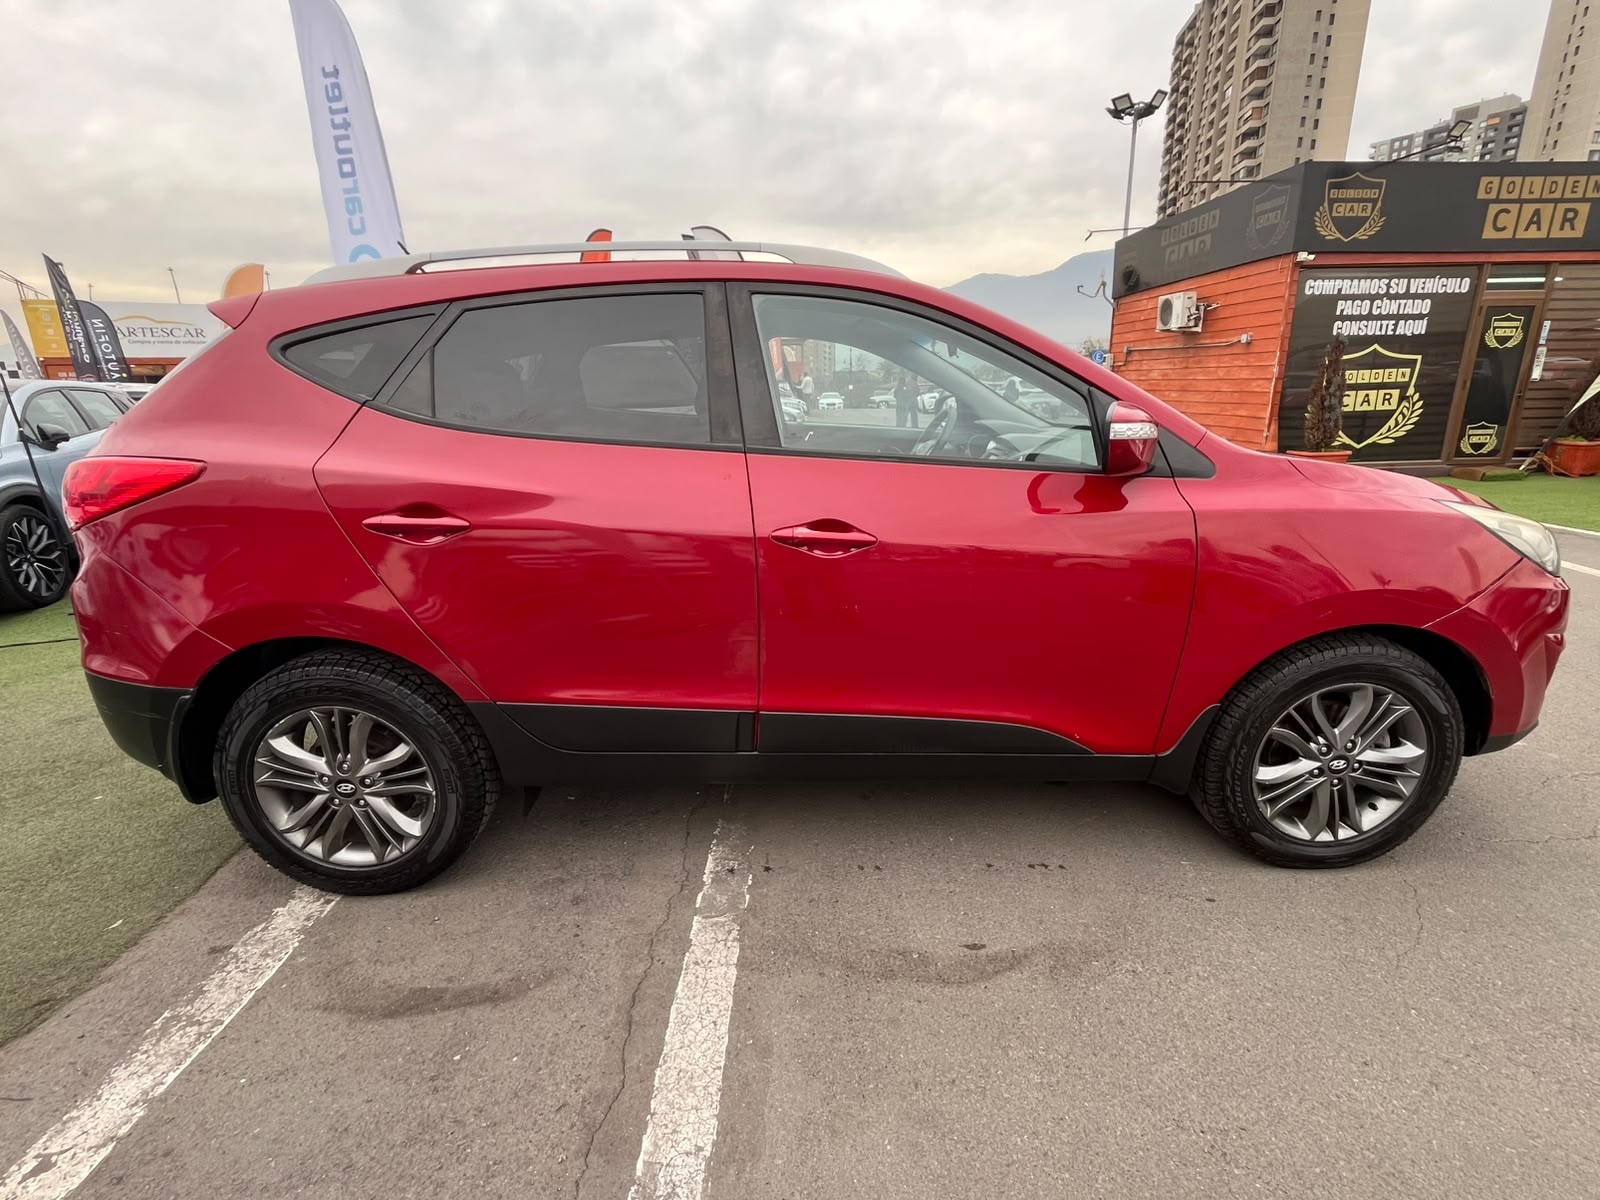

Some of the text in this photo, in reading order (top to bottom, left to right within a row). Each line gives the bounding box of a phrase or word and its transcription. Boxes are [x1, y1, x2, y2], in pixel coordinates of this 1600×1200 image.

[1482, 179, 1600, 196] GOLDEN
[1334, 204, 1370, 215] CAR
[1489, 206, 1583, 234] CAR
[1304, 275, 1471, 295] COMPRAMOS SU VEHÍCULO
[1336, 299, 1371, 315] PAGO
[1333, 316, 1429, 337] CONSULTE AQUÍ
[1346, 370, 1408, 382] OLDEN
